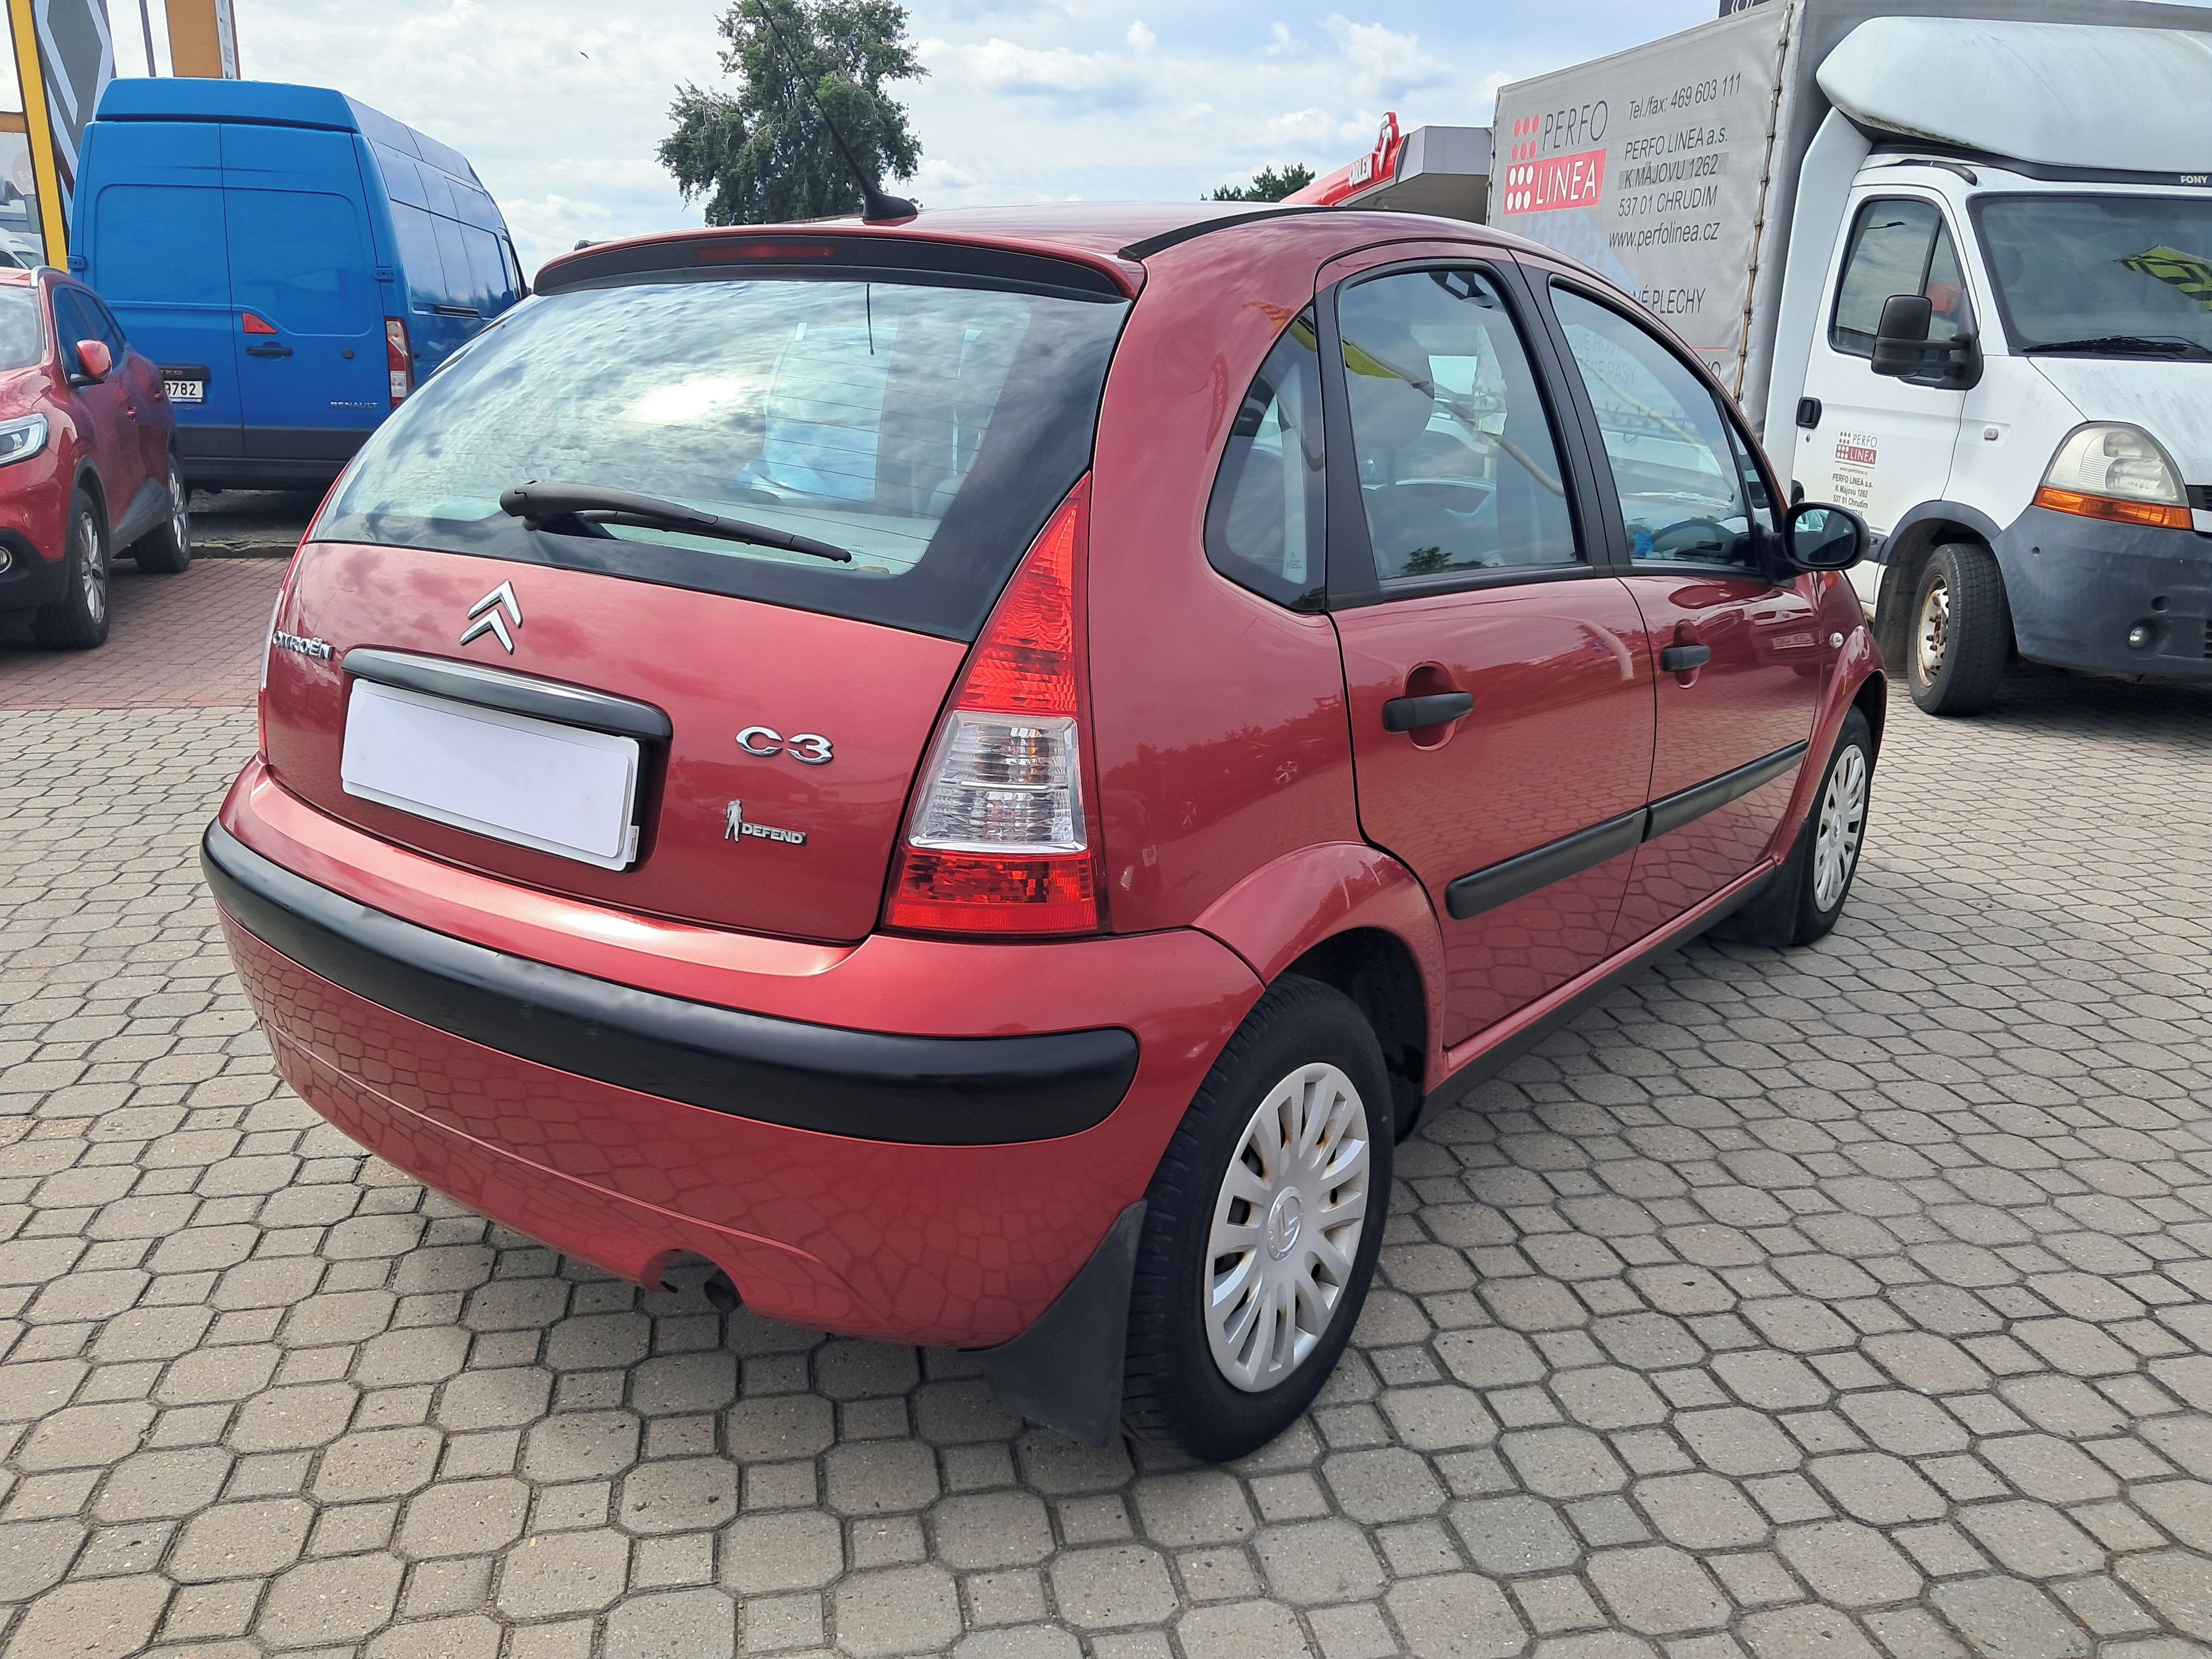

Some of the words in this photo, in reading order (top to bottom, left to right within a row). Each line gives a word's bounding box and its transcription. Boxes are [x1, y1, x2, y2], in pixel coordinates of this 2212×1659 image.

[1630, 95, 1668, 120] Tel./fax:
[1670, 86, 1692, 109] 469
[1695, 79, 1717, 104] 603
[1722, 72, 1741, 97] 111
[1543, 100, 1608, 151] PERFO
[1624, 136, 1665, 162] PERFO
[1667, 127, 1704, 153] LINEA
[1707, 127, 1728, 146] a.s.
[1349, 153, 1372, 187] ORLEN
[1536, 158, 1597, 205] LINEA
[1624, 169, 1634, 189] K
[1635, 161, 1686, 187] MÁJOVU
[1689, 153, 1718, 178] 1262
[2180, 175, 2208, 184] FONY
[1618, 197, 1638, 217] 537
[1640, 194, 1653, 215] 01
[1657, 184, 1718, 213] CHRUDIM
[1609, 221, 1721, 252] www.perfolinea.cz
[1652, 288, 1706, 314] PLECHY
[164, 382, 196, 396] 9782
[1850, 448, 1874, 462] LINEA
[1852, 434, 1877, 448] PERFO
[1832, 473, 1849, 483] PERFO
[1849, 476, 1863, 486] LINEA
[1857, 488, 1868, 498] 1262
[1833, 494, 1841, 503] 537
[1842, 496, 1847, 504] 01
[1848, 498, 1868, 509] Chrudim
[273, 631, 335, 661] CITROËN
[735, 725, 834, 765] C3
